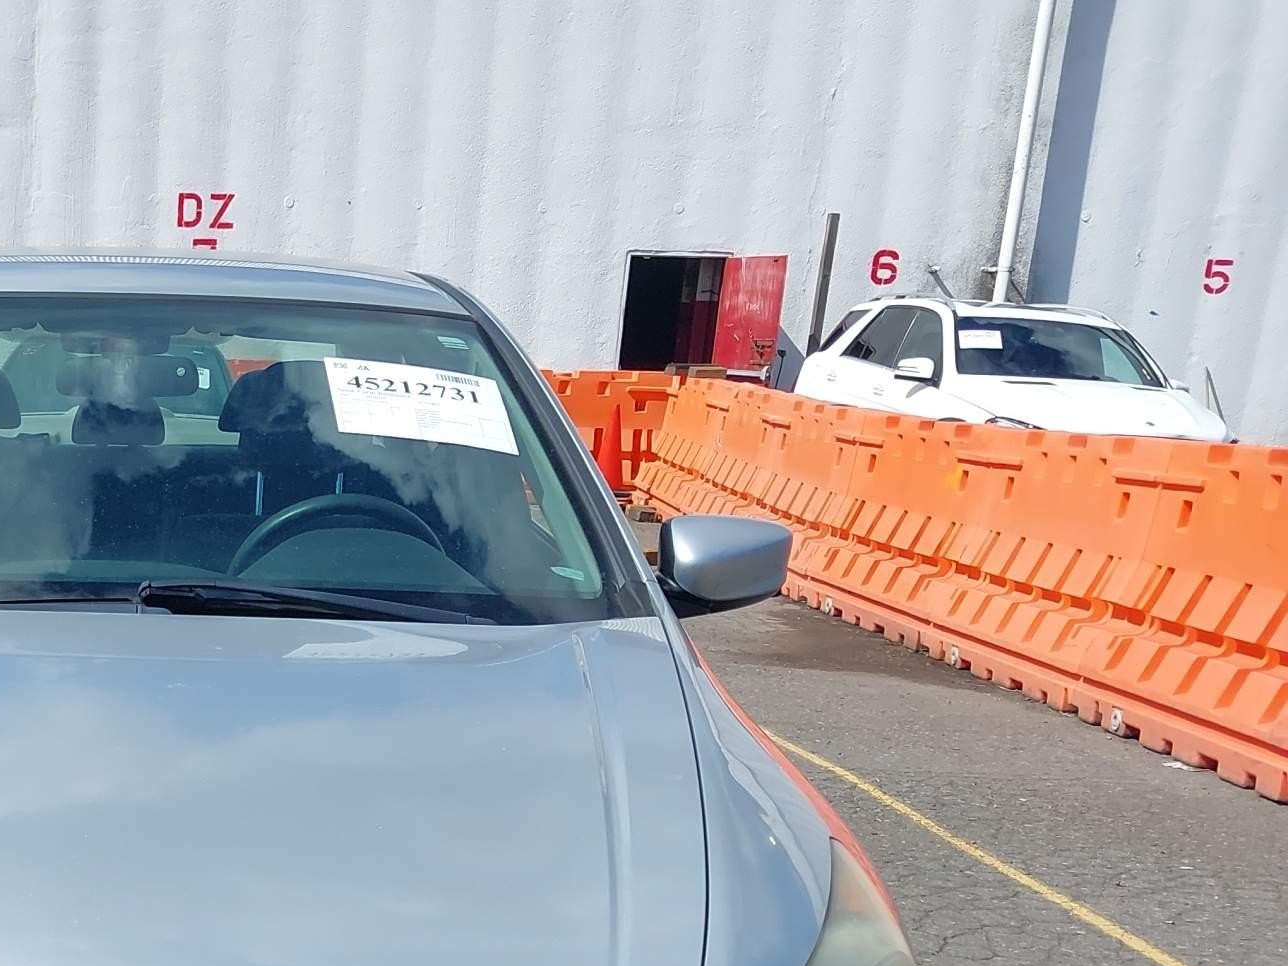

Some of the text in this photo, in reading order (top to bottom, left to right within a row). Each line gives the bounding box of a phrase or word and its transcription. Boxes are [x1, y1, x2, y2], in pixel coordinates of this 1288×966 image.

[177, 193, 235, 229] DZ
[871, 250, 899, 285] 6
[1203, 259, 1234, 294] 5
[347, 375, 480, 404] 45212731
